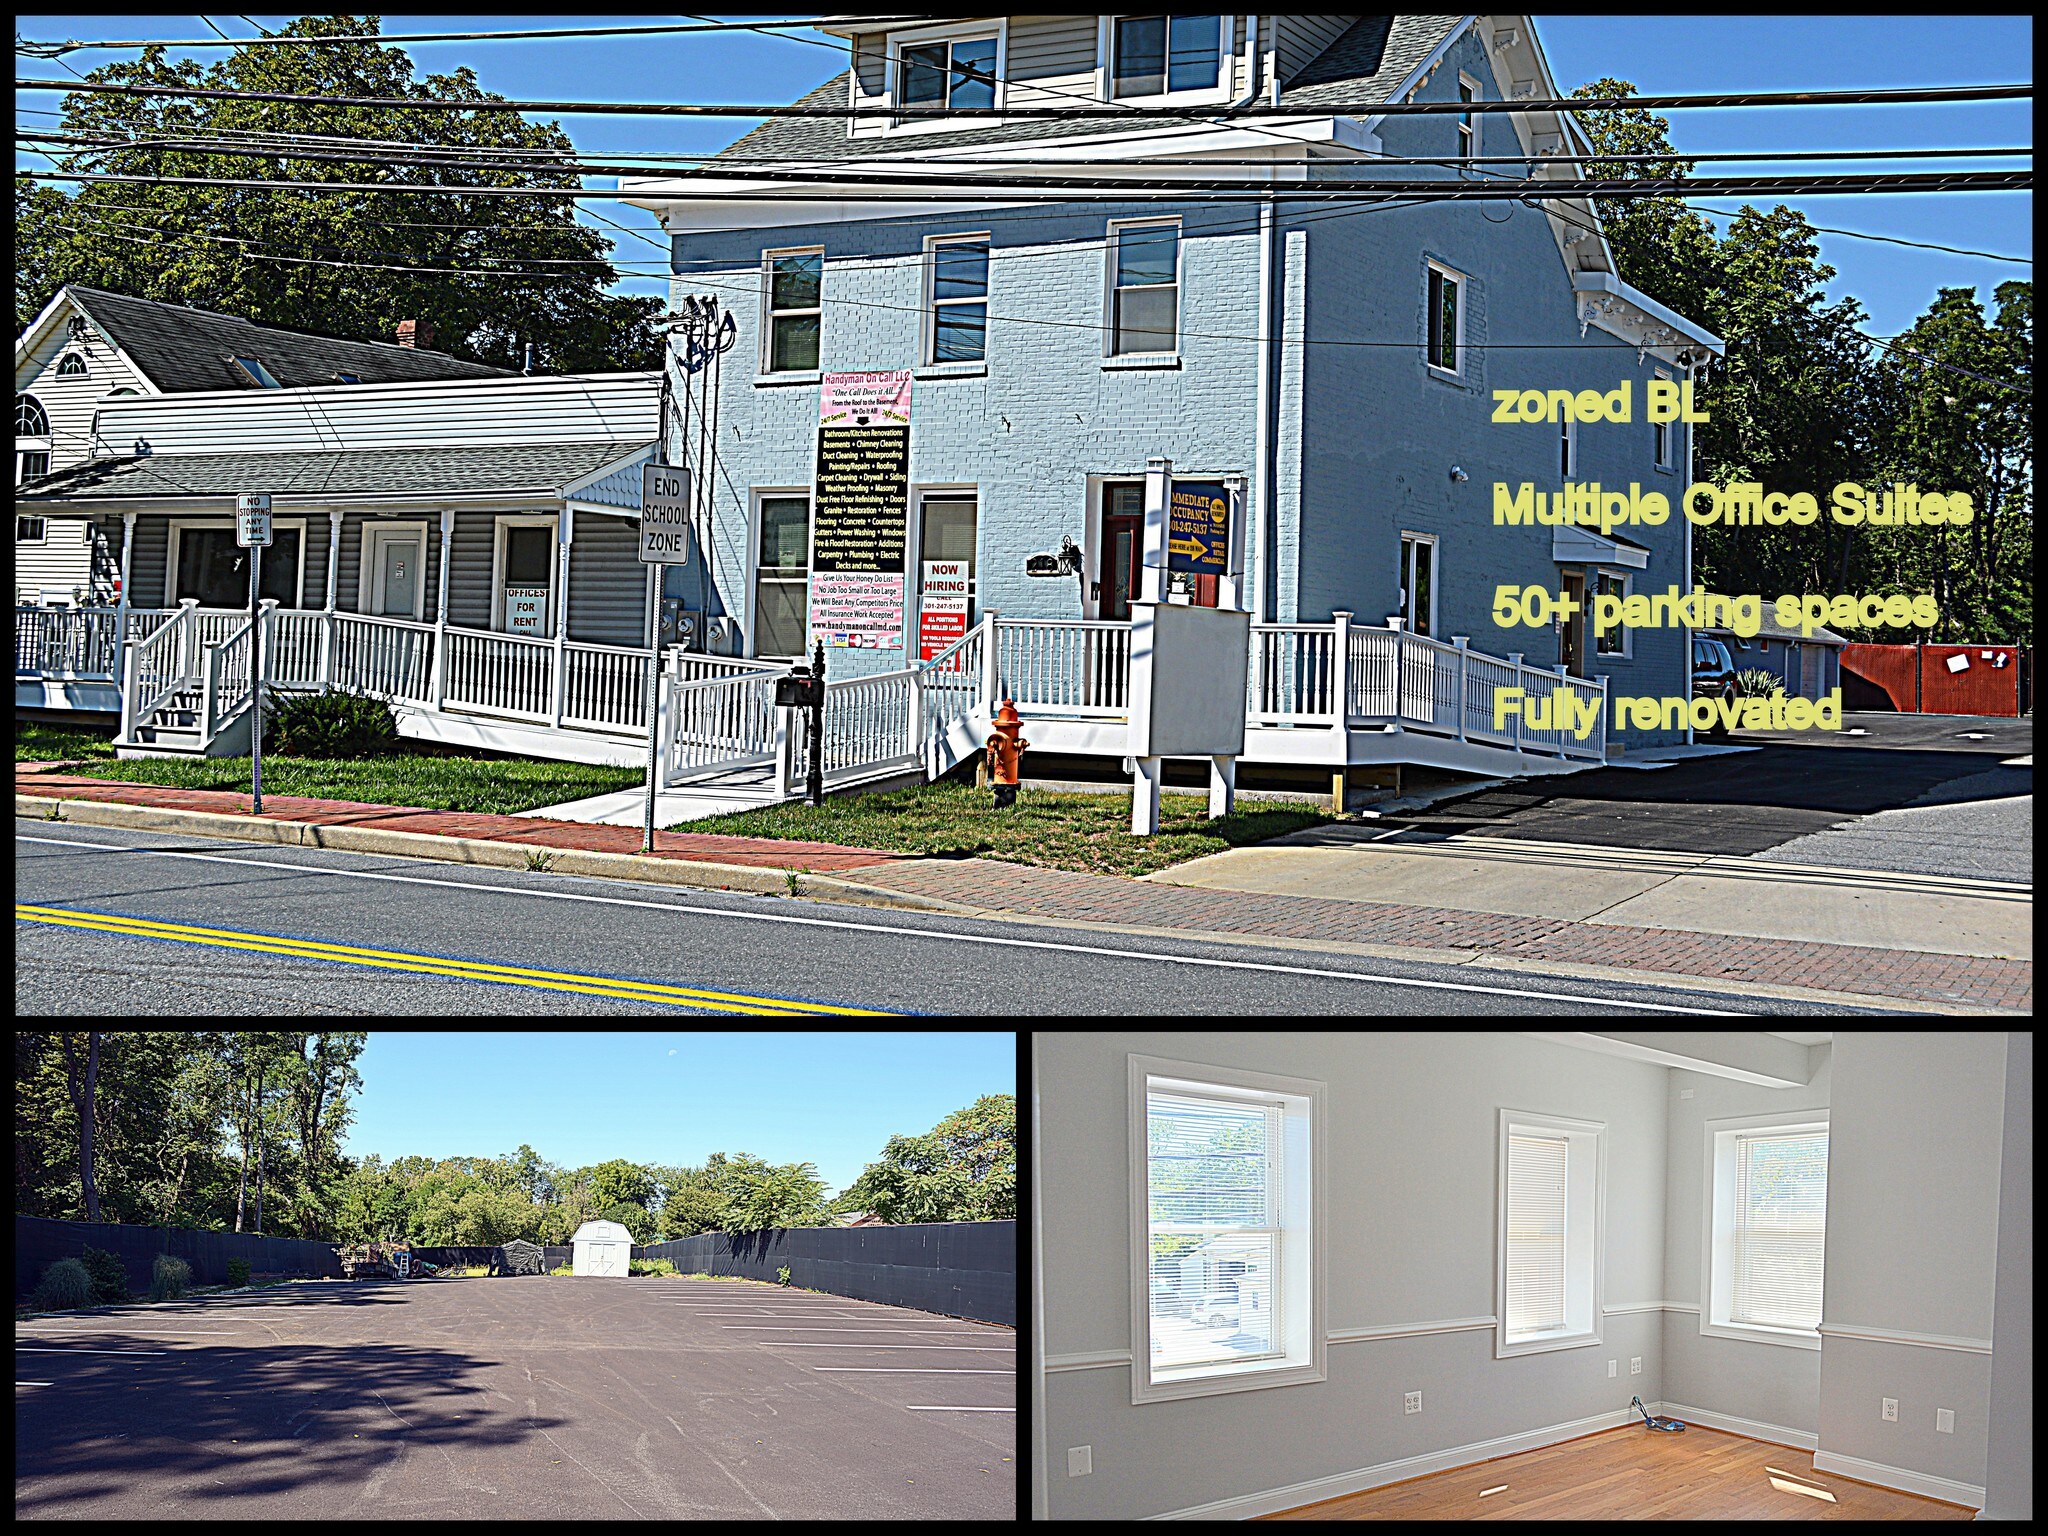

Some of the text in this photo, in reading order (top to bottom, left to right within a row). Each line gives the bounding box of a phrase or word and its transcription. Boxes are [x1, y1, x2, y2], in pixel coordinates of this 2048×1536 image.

[826, 371, 910, 386] Handyman On Call LLC
[848, 388, 860, 396] Call
[863, 387, 877, 396] Does
[878, 387, 884, 395] it
[830, 412, 847, 421] Service
[882, 409, 908, 424] 24/7 Service
[824, 429, 903, 438] Bathroom/Kitchen Renovations
[856, 440, 879, 449] Chimney
[880, 440, 903, 448] Cleaning
[836, 452, 858, 460] Cleaning
[865, 451, 902, 460] Waterproofing
[829, 462, 896, 471] Painting/Repairs Roofing
[818, 473, 906, 482] Carpet Cleaning Drywall Siding
[655, 478, 679, 497] END
[825, 484, 897, 493] Weather Proofing Masonry
[247, 497, 260, 506] NO
[855, 495, 883, 504] Refinishing
[890, 495, 906, 503] Doors
[1172, 492, 1209, 508] MMEDIATE
[240, 508, 270, 517] STOPPING
[645, 504, 687, 525] SCHOOL
[824, 506, 901, 514] Granite Restoration Fences
[816, 518, 837, 526] Flooring
[872, 518, 904, 526] Countertops
[837, 528, 853, 536] Power
[854, 529, 876, 537] Washing
[648, 532, 682, 552] ZONE
[818, 550, 899, 560] Carpentry Plumbing Electric
[932, 564, 958, 575] NOW
[856, 575, 873, 583] Honey
[849, 586, 863, 594] Small
[882, 587, 897, 596] Large
[924, 581, 965, 592] HIRING
[508, 589, 545, 598] OFFICES
[517, 602, 535, 612] FOR
[845, 599, 854, 607] Any
[856, 599, 888, 608] Competitors
[890, 599, 903, 607] Price
[869, 611, 894, 620] Accepted
[513, 617, 538, 627] RENT
[812, 621, 901, 631] www.handymanoncallmd.com
